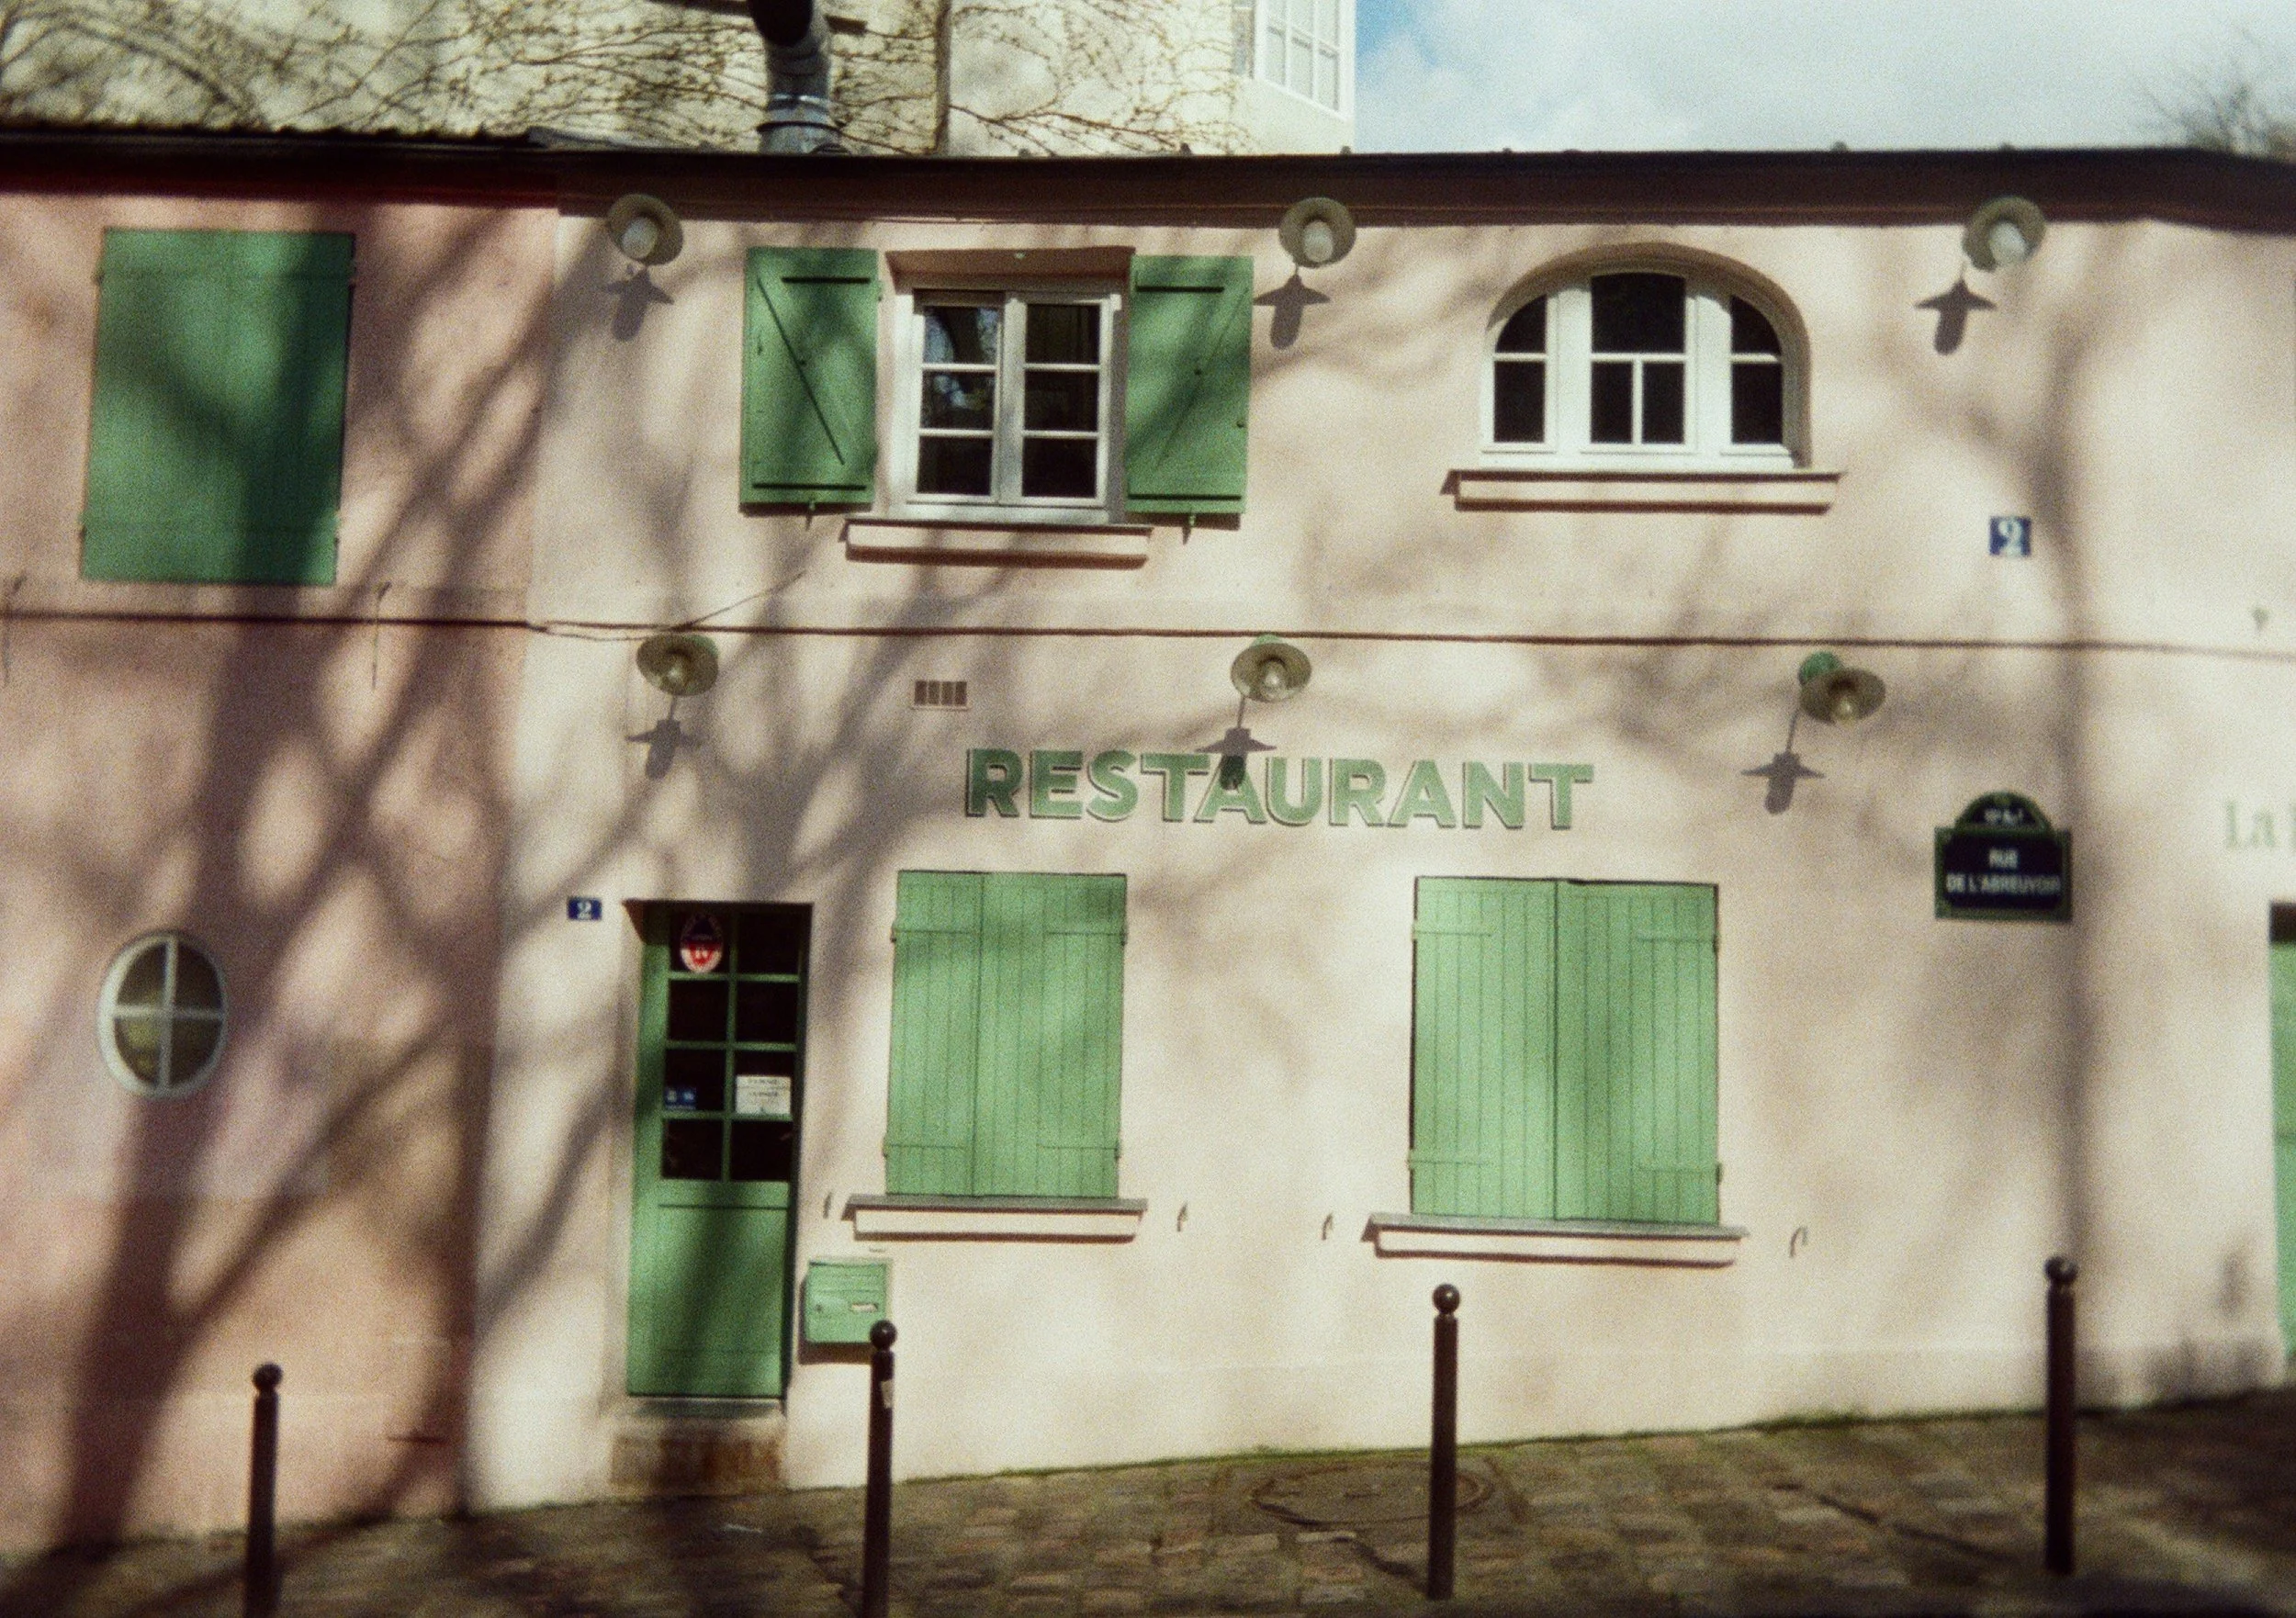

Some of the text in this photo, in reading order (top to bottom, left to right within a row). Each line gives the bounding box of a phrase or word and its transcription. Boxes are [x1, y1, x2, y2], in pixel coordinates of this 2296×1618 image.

[1998, 519, 2023, 556] 2
[964, 747, 1594, 831] RESTAURANT
[577, 902, 592, 920] 2
